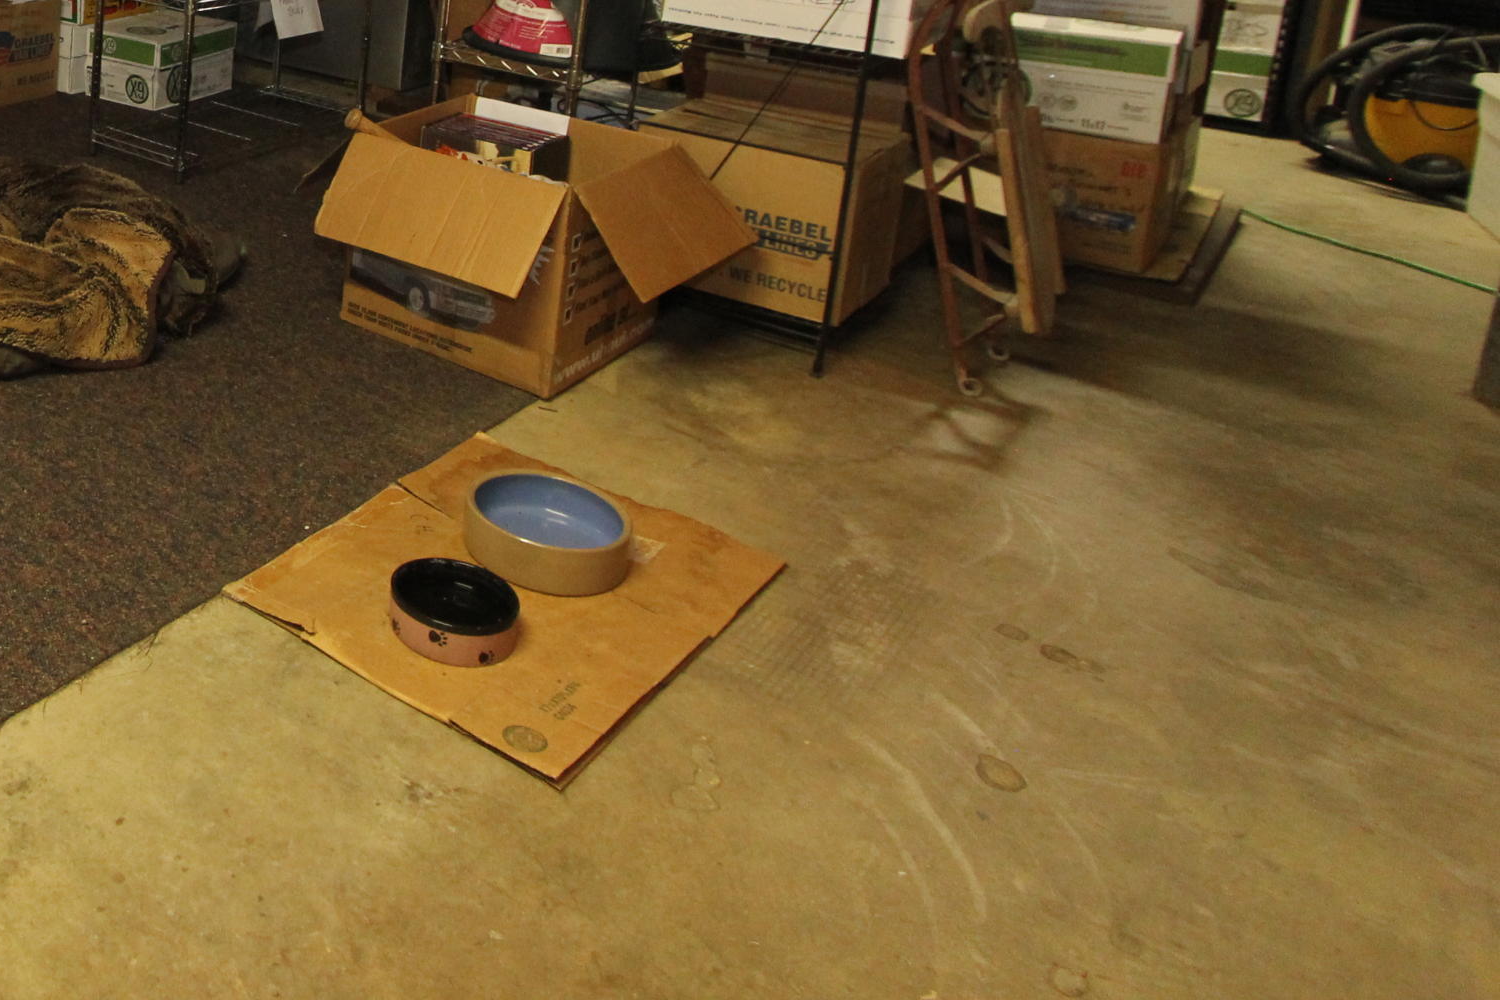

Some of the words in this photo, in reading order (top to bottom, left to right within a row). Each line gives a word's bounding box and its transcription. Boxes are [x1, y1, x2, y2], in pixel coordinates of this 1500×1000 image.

[736, 206, 833, 243] RAEBEL
[729, 266, 753, 284] WE
[756, 271, 827, 303] RECYCLE
